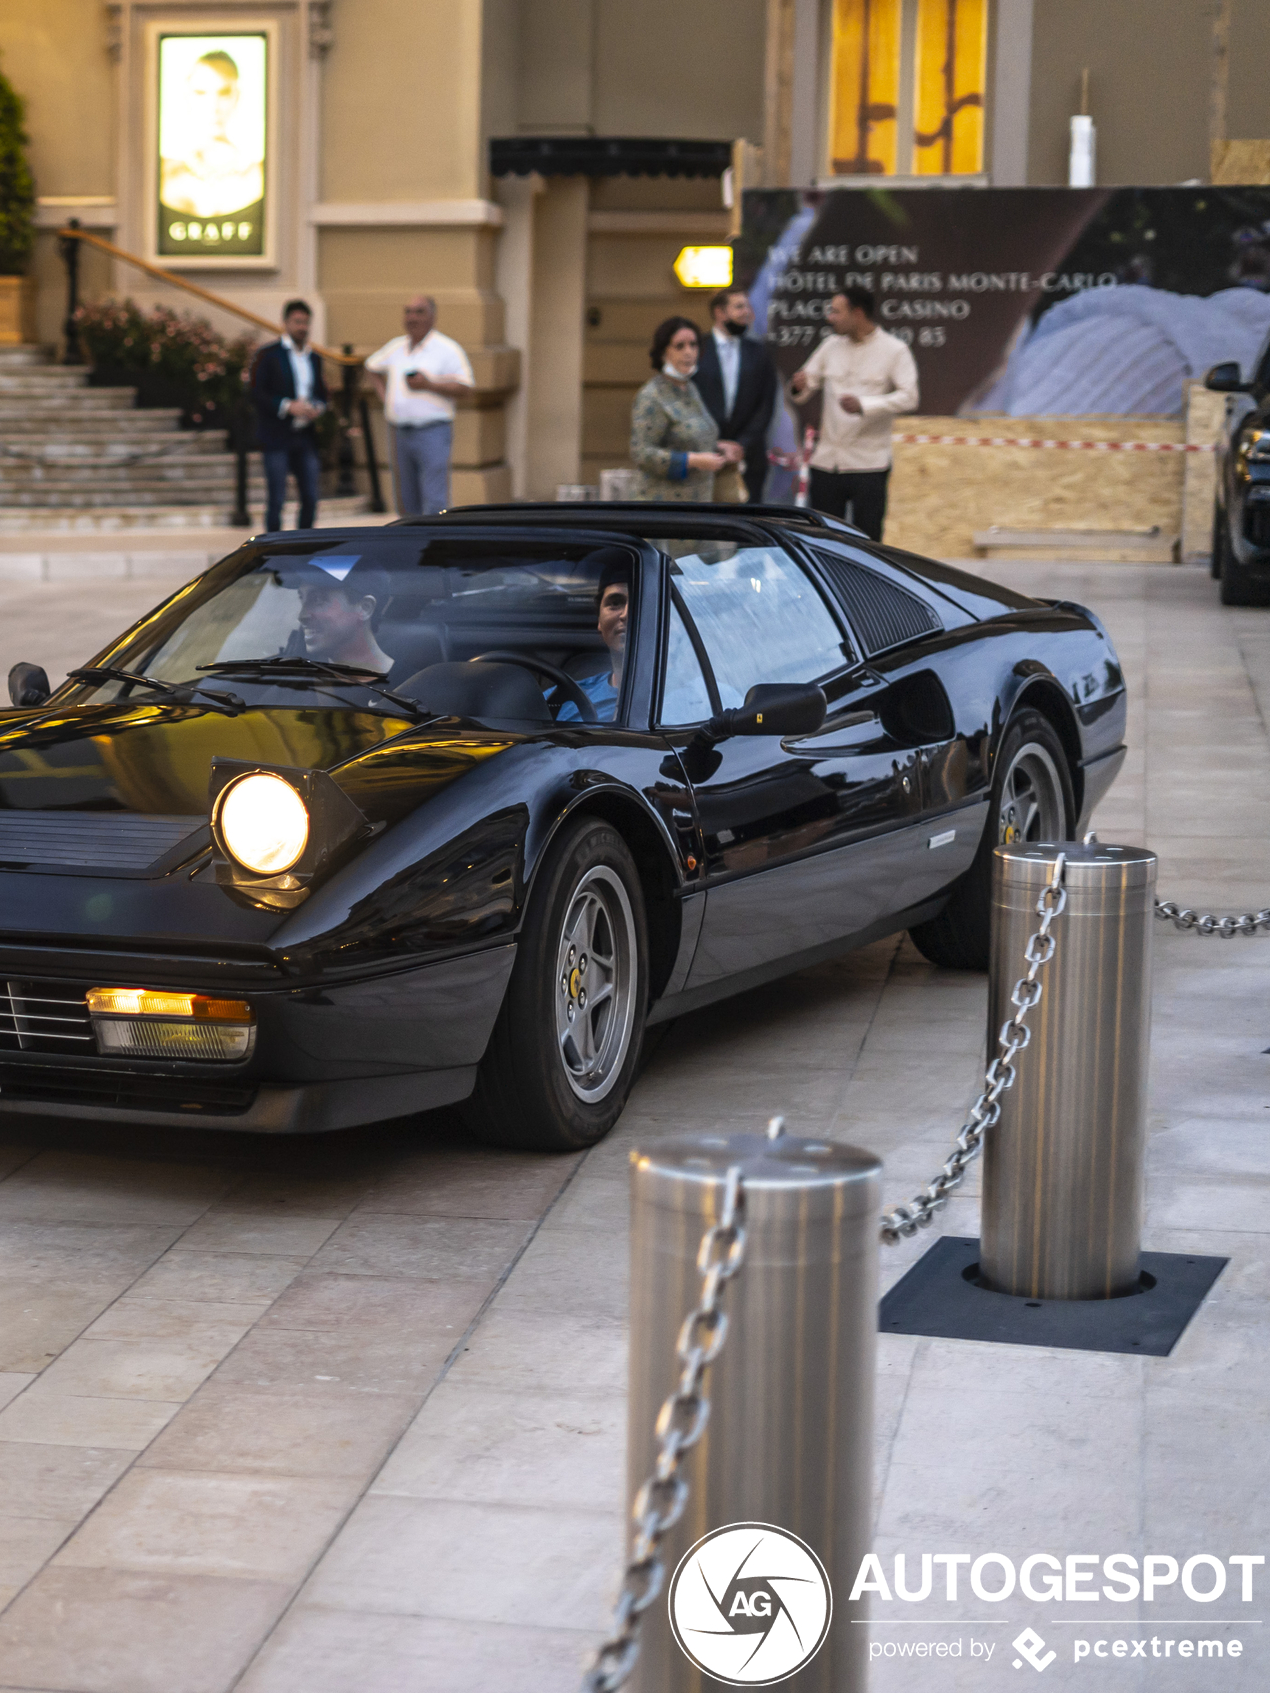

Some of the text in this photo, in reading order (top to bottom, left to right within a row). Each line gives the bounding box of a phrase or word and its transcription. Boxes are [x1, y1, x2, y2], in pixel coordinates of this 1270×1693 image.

[168, 221, 253, 241] GRAFF
[768, 244, 920, 266] WE ARE OPEN
[768, 268, 1118, 293] HÔTEL DE PARIS MONTE-CARLO
[767, 298, 971, 320] PLACE CASINO
